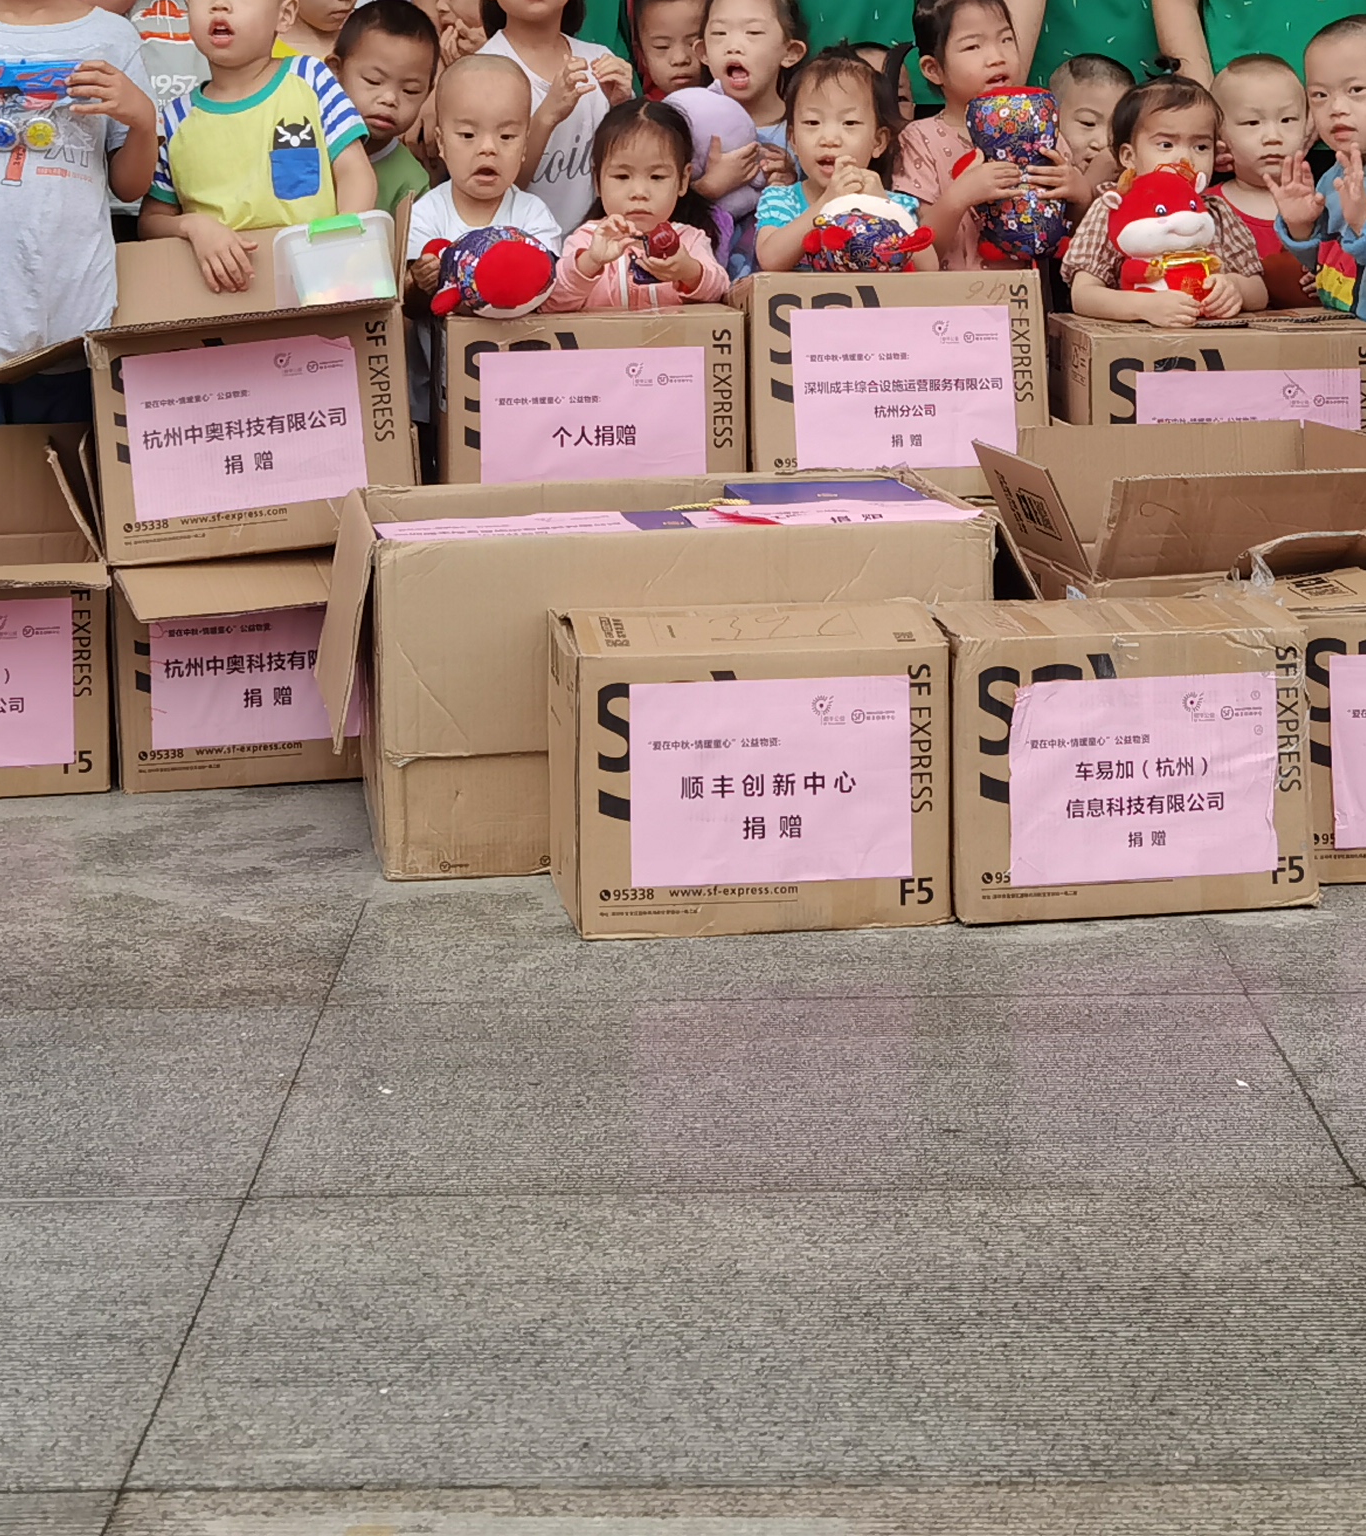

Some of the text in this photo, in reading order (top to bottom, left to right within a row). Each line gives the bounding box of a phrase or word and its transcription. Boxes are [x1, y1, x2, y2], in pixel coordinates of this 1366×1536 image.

[1009, 283, 1034, 403] SF EXPRESS
[365, 320, 396, 443] SF EXPRESS
[712, 328, 733, 449] SF EXPRESS
[804, 376, 1004, 396] 深圳成丰综合设施运营服务有限公司
[874, 404, 936, 419] 杭州分公司
[142, 407, 348, 451] 杭州中奥科技有限公司
[552, 424, 637, 448] 个人捐赠
[891, 434, 923, 448] 捐赠
[224, 450, 274, 475] 捐赠
[134, 507, 288, 533] 95338 www.sf-express.com
[70, 589, 92, 697] F EXPRESS
[243, 686, 293, 708] 捐赠
[1275, 646, 1302, 793] SF EXPRESS
[149, 740, 303, 761] 95338 www.sf-express.com
[907, 664, 933, 814] SF EXPRESS
[1074, 756, 1208, 782] 车易加（杭州）
[680, 770, 857, 800] 顺丰创新中心
[1065, 791, 1225, 820] 信息科技有限公司
[742, 814, 803, 841] 捐赠
[1128, 830, 1167, 848] 捐赠
[612, 884, 799, 902] 95338 www.sf-express.com
[899, 877, 935, 907] F5
